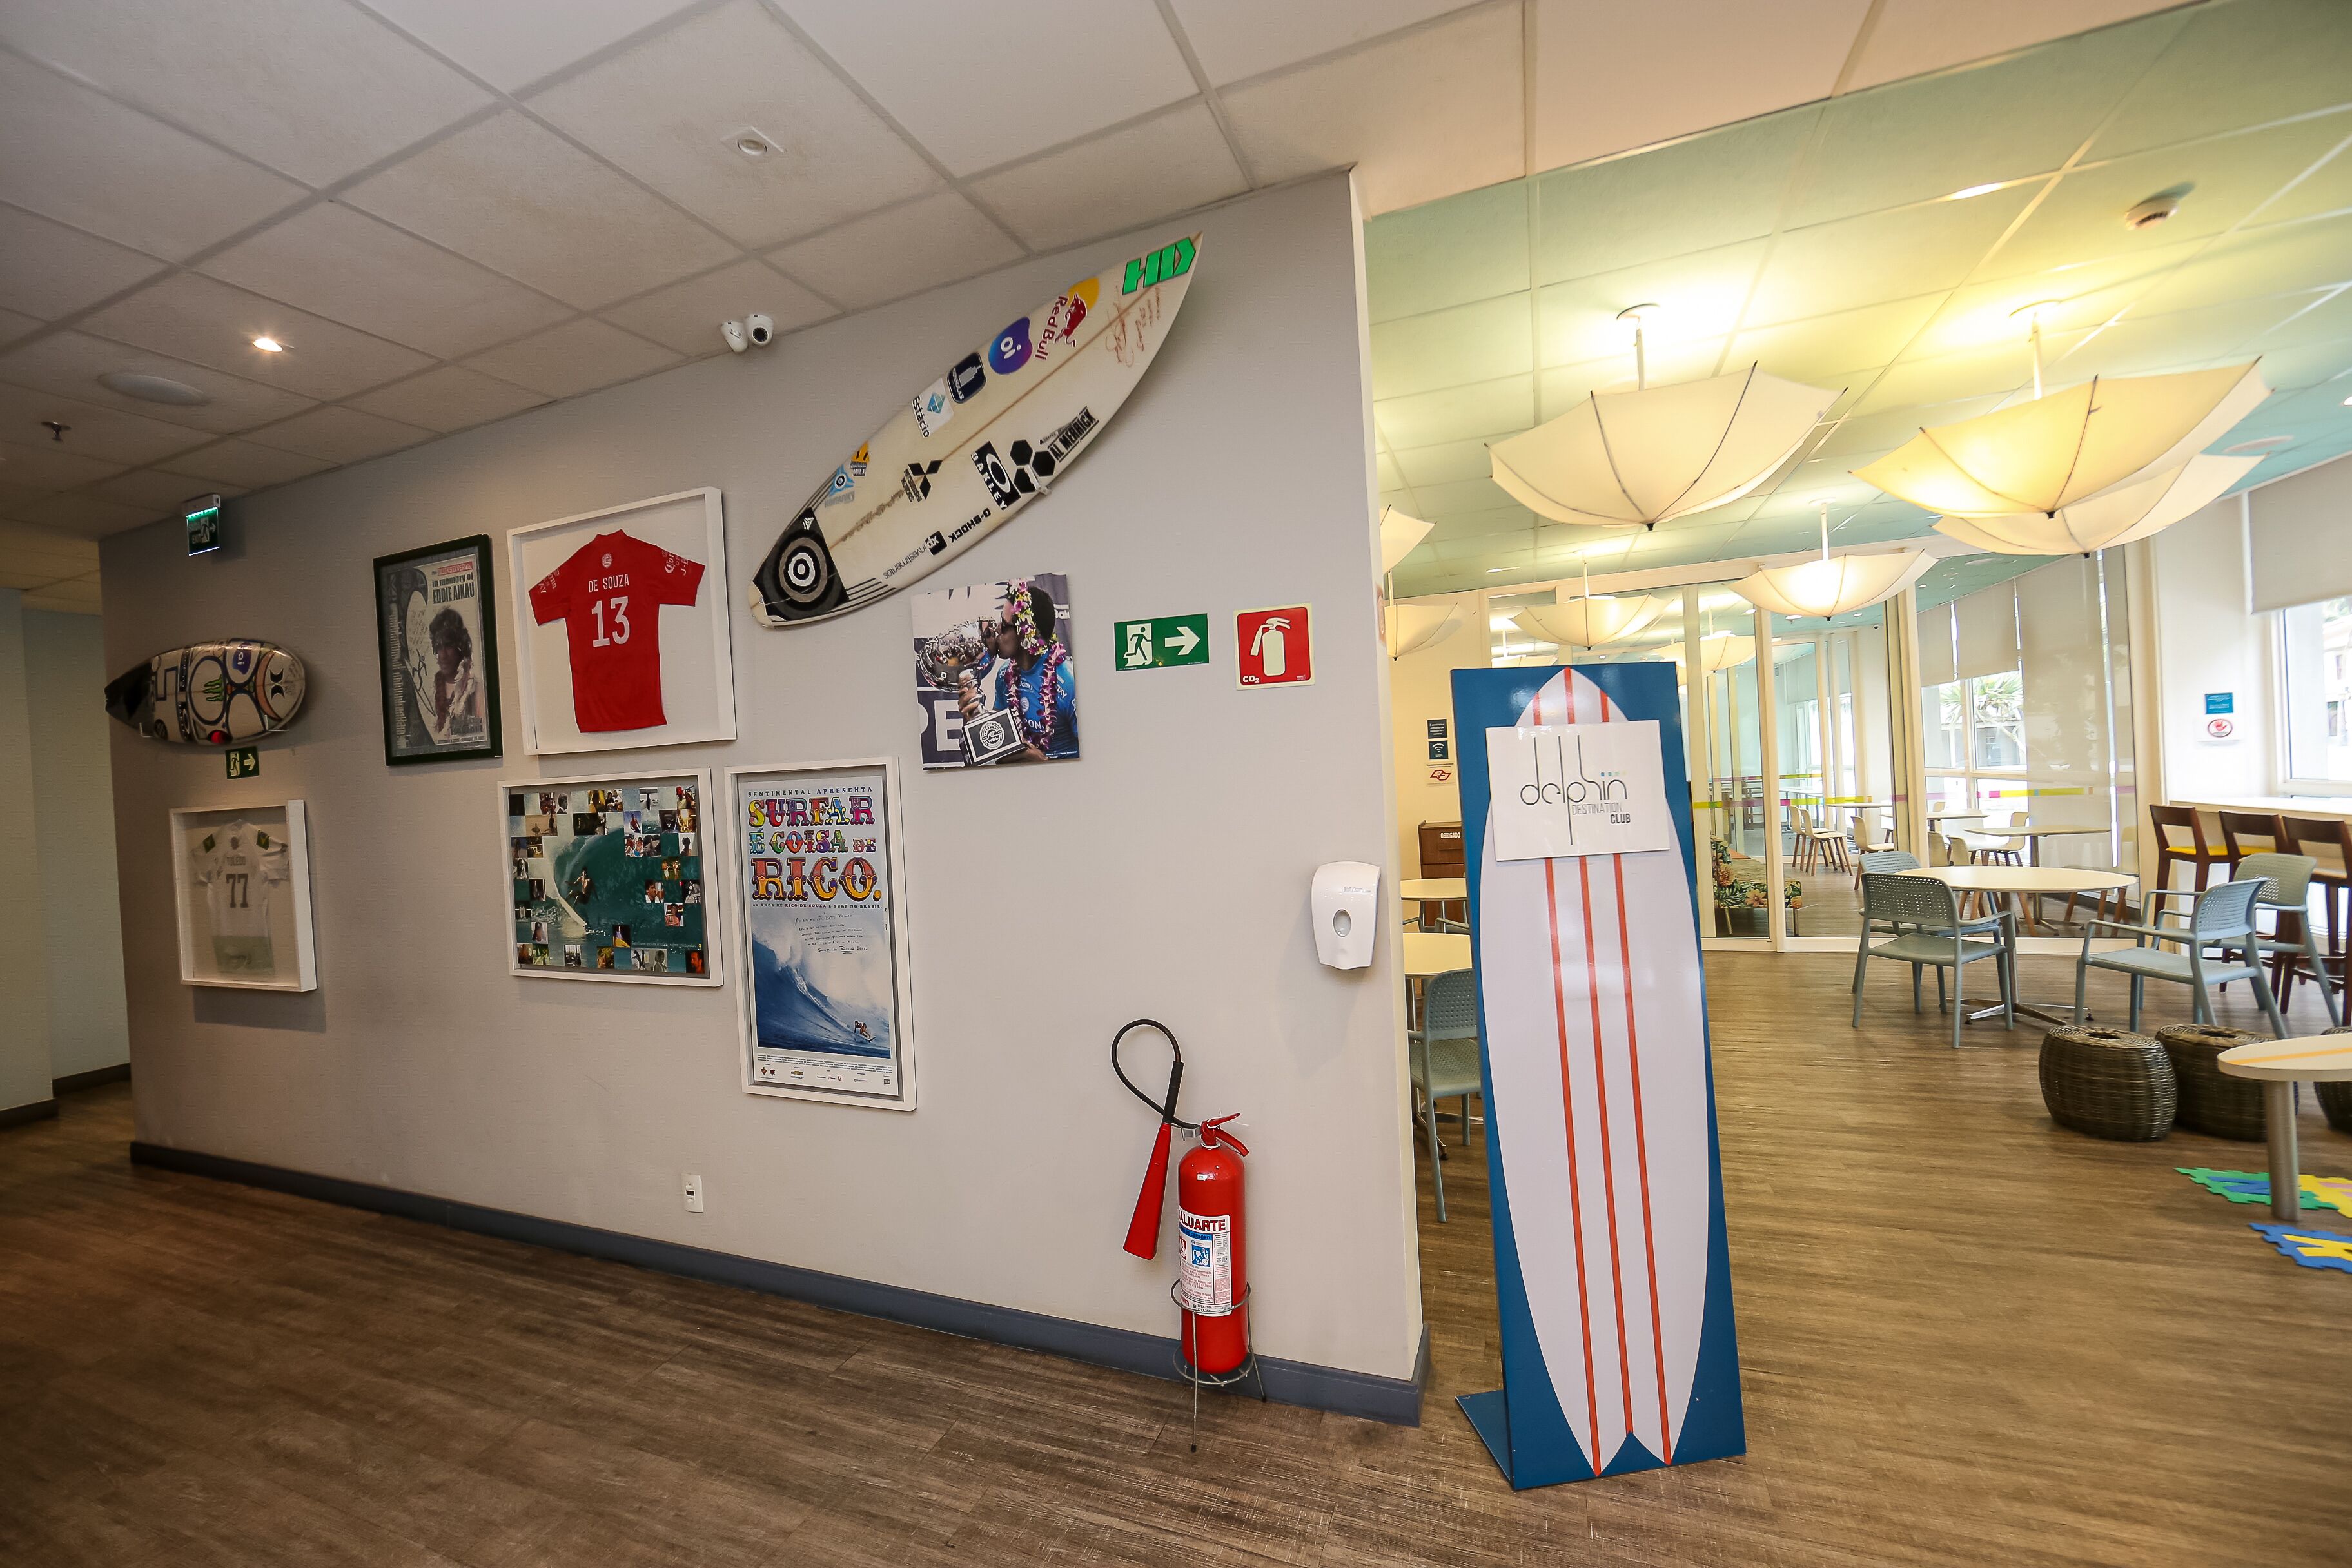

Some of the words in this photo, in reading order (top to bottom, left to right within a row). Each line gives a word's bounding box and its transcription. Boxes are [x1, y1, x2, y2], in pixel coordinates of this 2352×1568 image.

[1122, 237, 1196, 295] HD
[1047, 295, 1068, 328] Red
[1035, 328, 1056, 360] Bull
[912, 396, 930, 438] Estácio
[1048, 443, 1064, 461] AL
[1059, 408, 1097, 452] MERRICK
[970, 452, 1008, 510] OAKLEY
[948, 508, 992, 543] G-SHOCK
[883, 545, 926, 579] investimentos
[433, 587, 452, 604] EDDIE
[453, 582, 475, 600] AIKAU
[440, 575, 466, 586] memory
[589, 580, 598, 593] DE
[603, 574, 629, 590] SOUZA
[591, 596, 630, 647] 13
[1520, 735, 1627, 845] delphin
[748, 796, 875, 827] SURFAR
[1572, 802, 1623, 815] DESTINATION
[1610, 813, 1631, 824] CLUB
[749, 828, 765, 854] É
[769, 830, 848, 854] COISA
[852, 838, 877, 853] DE
[226, 874, 249, 908] 77
[751, 857, 882, 902] RICO.
[1179, 1208, 1226, 1231] ALUARTE
